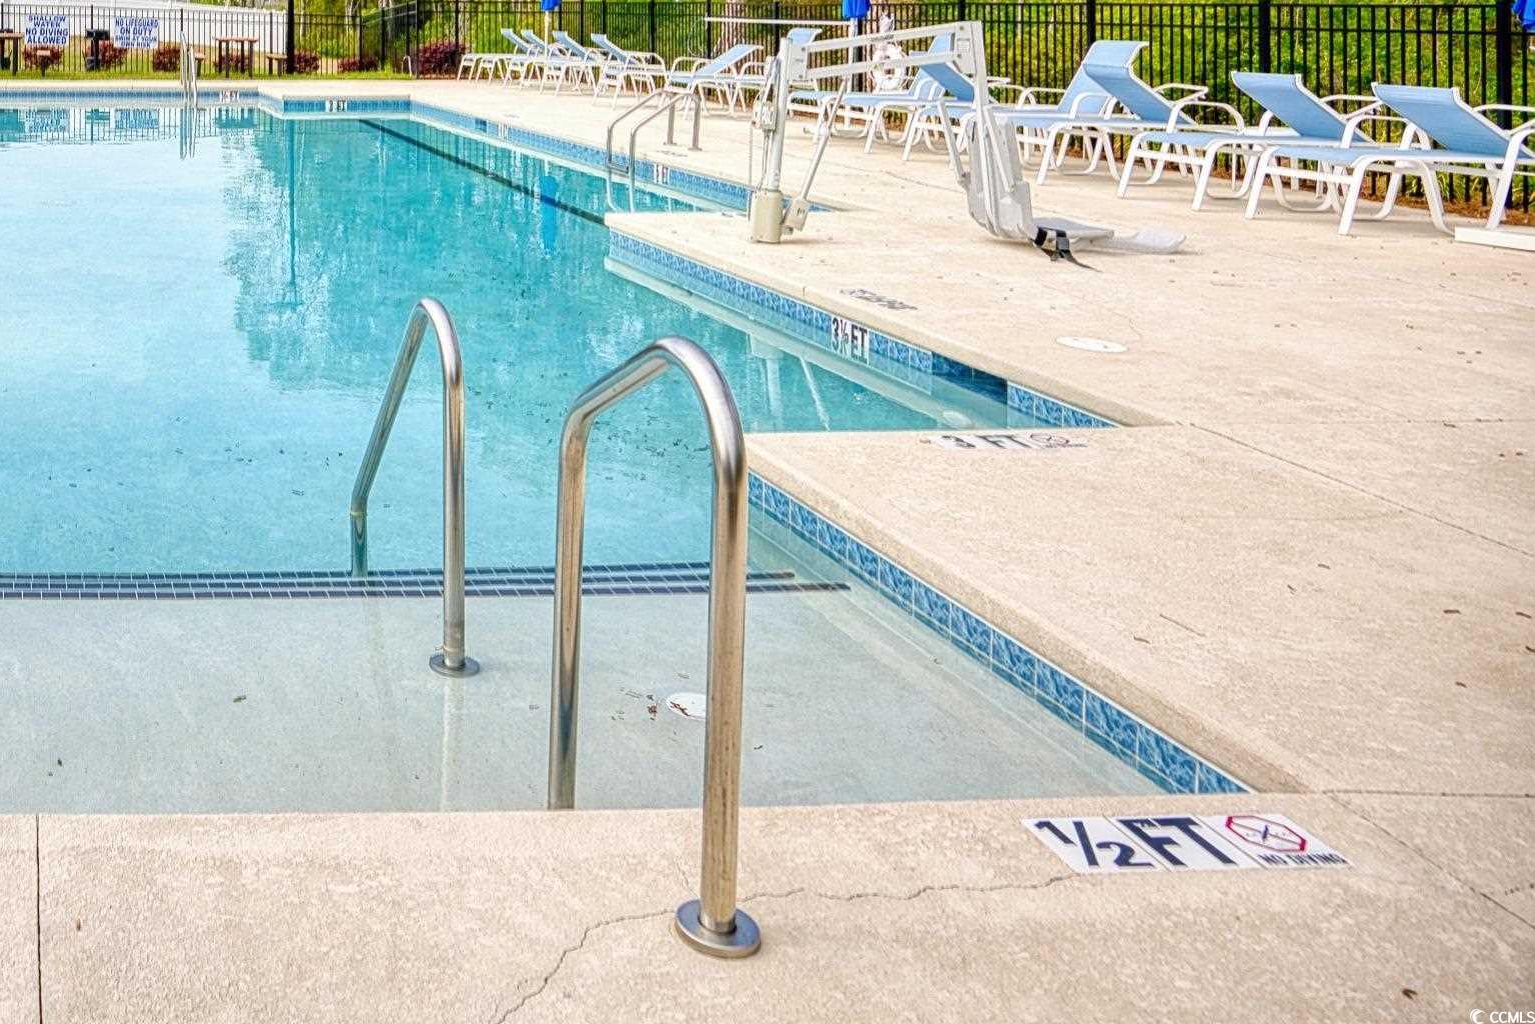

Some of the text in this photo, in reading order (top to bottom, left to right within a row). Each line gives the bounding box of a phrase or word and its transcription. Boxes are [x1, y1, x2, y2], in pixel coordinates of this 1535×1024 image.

[115, 18, 159, 28] NO LIFEGUARD
[25, 28, 69, 36] NO DIVING
[120, 27, 153, 36] ON DUTY
[26, 36, 67, 44] ALLOWED
[975, 434, 1033, 449] FT
[1117, 817, 1238, 868] FT
[1257, 853, 1348, 865] NO DIVING
